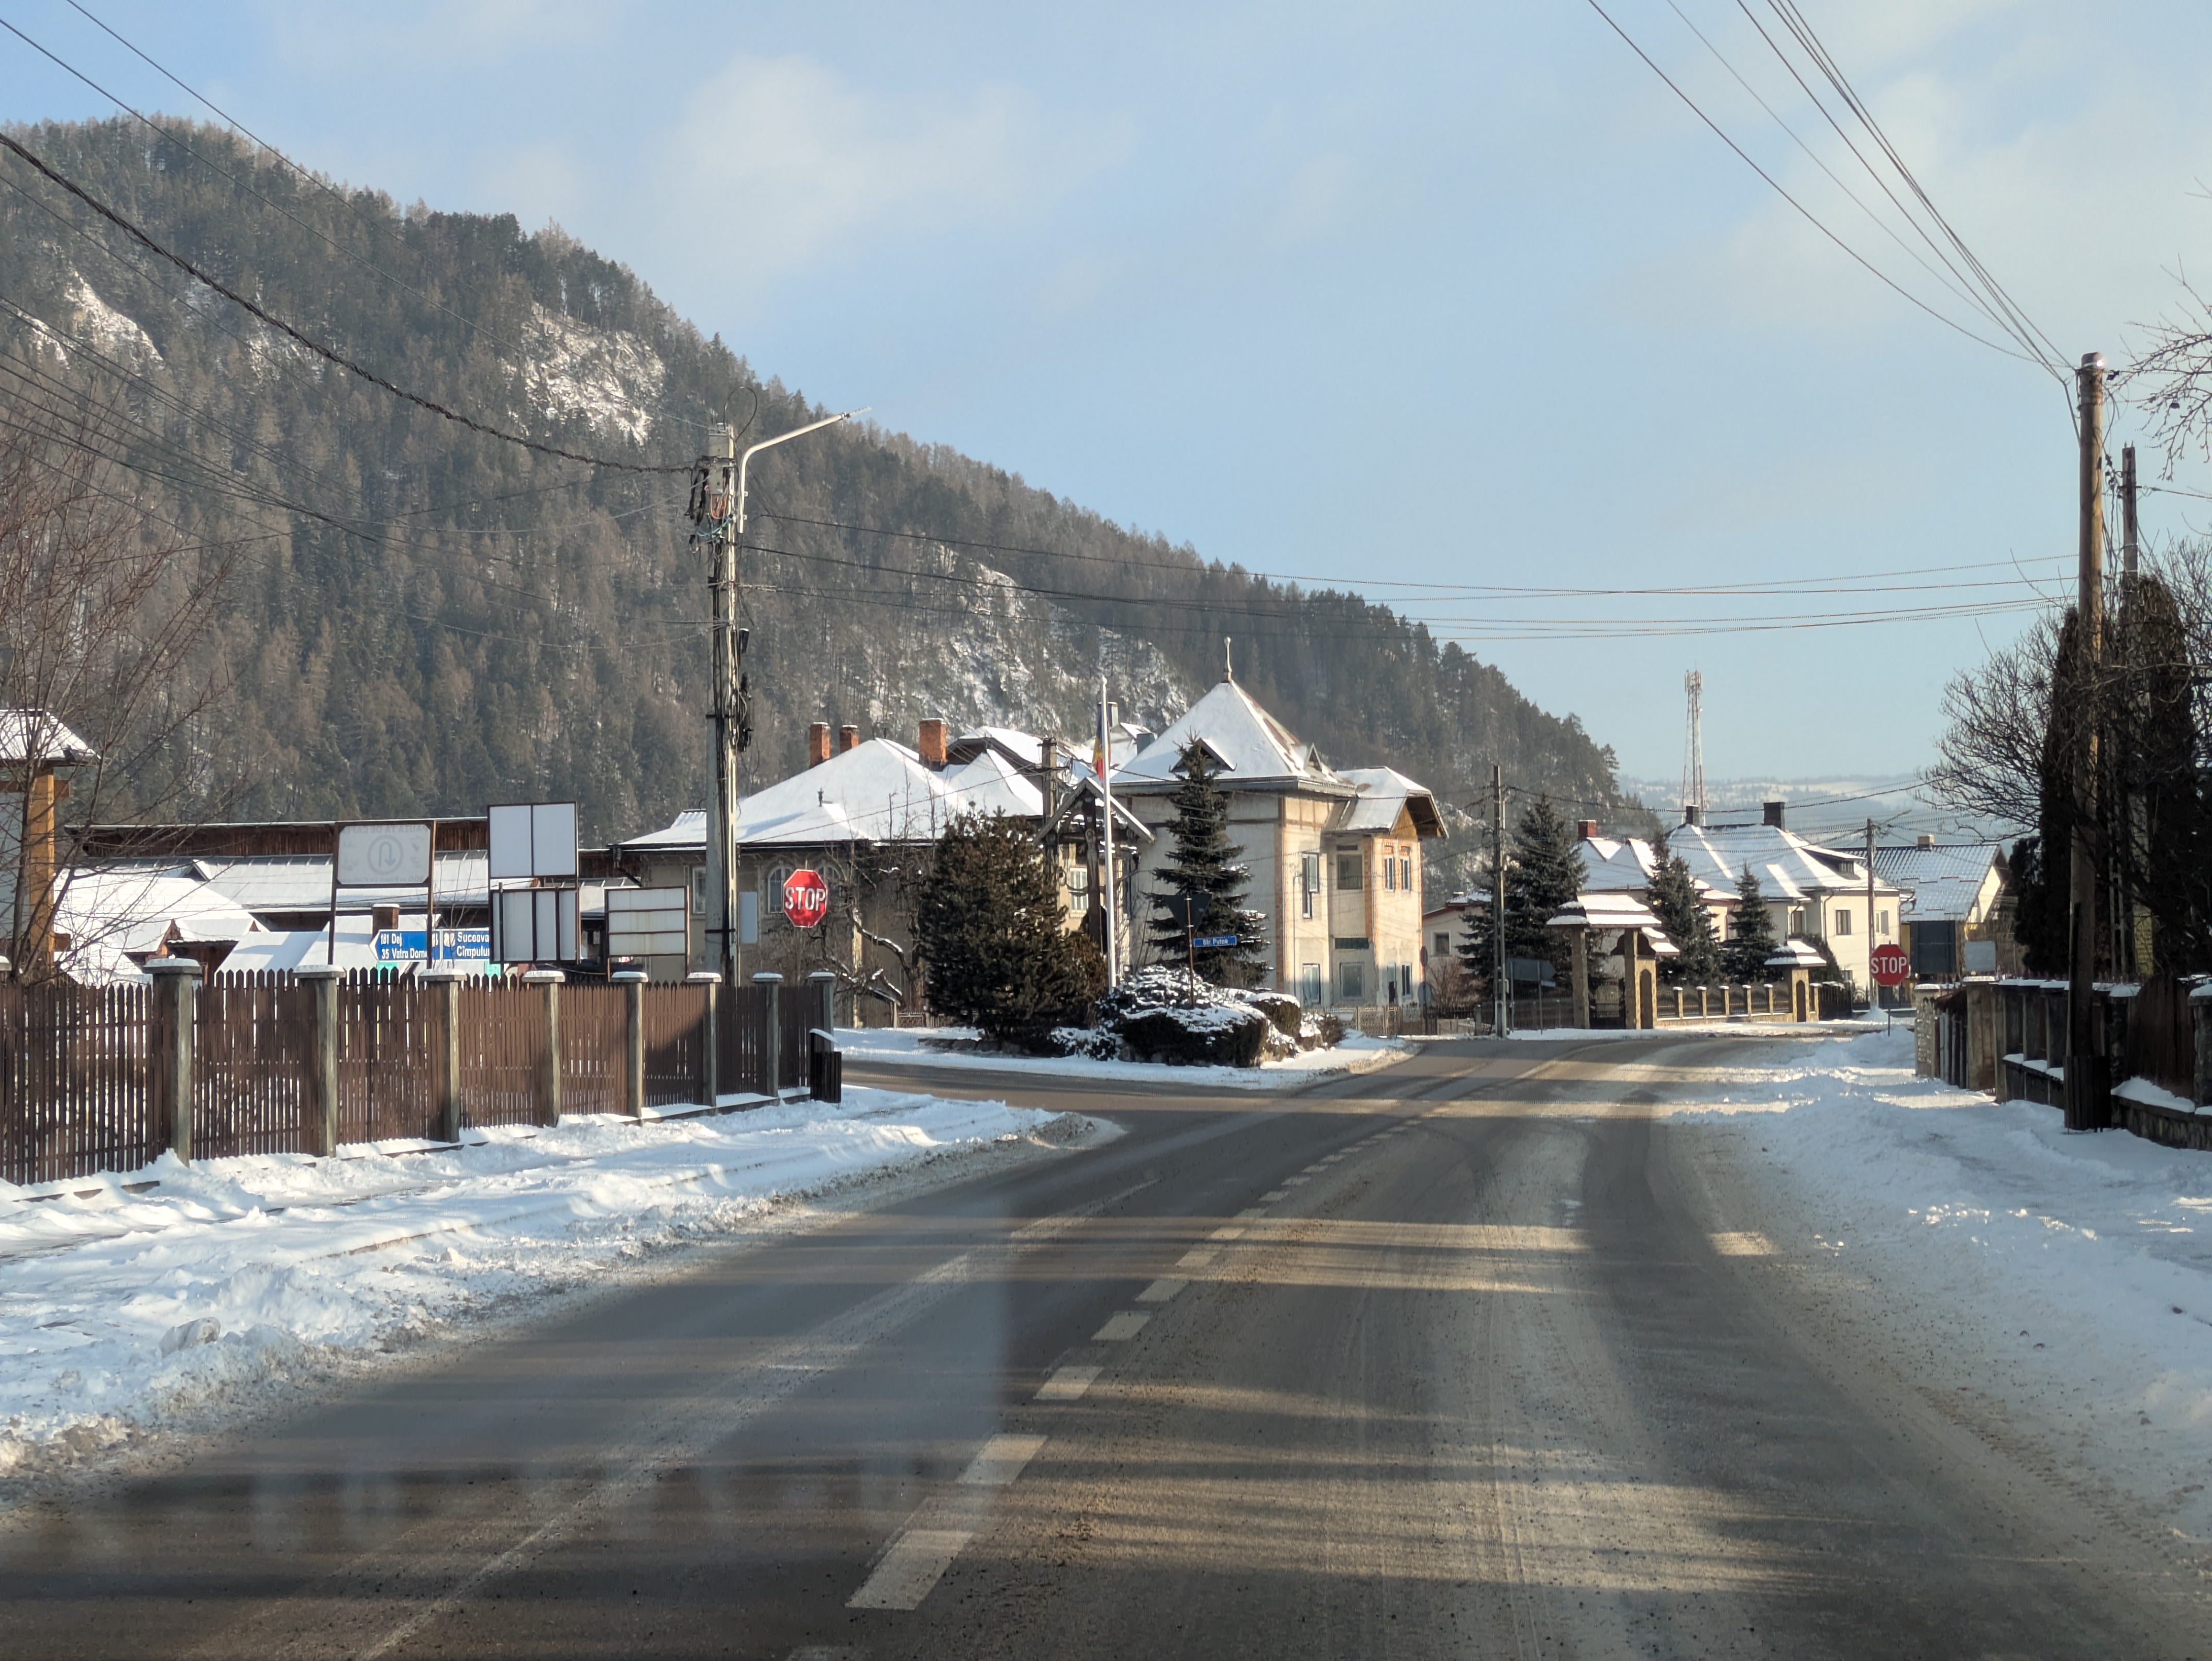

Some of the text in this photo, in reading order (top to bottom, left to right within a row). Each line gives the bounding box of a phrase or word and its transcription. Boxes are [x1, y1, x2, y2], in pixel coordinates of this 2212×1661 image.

[785, 886, 826, 911] STOP
[381, 933, 402, 947] 181 Dej
[457, 931, 489, 942] Suceava
[382, 949, 389, 959] 35
[391, 948, 409, 959] Vatra
[456, 945, 490, 959] Cîmpulu
[1871, 957, 1907, 974] STOP
